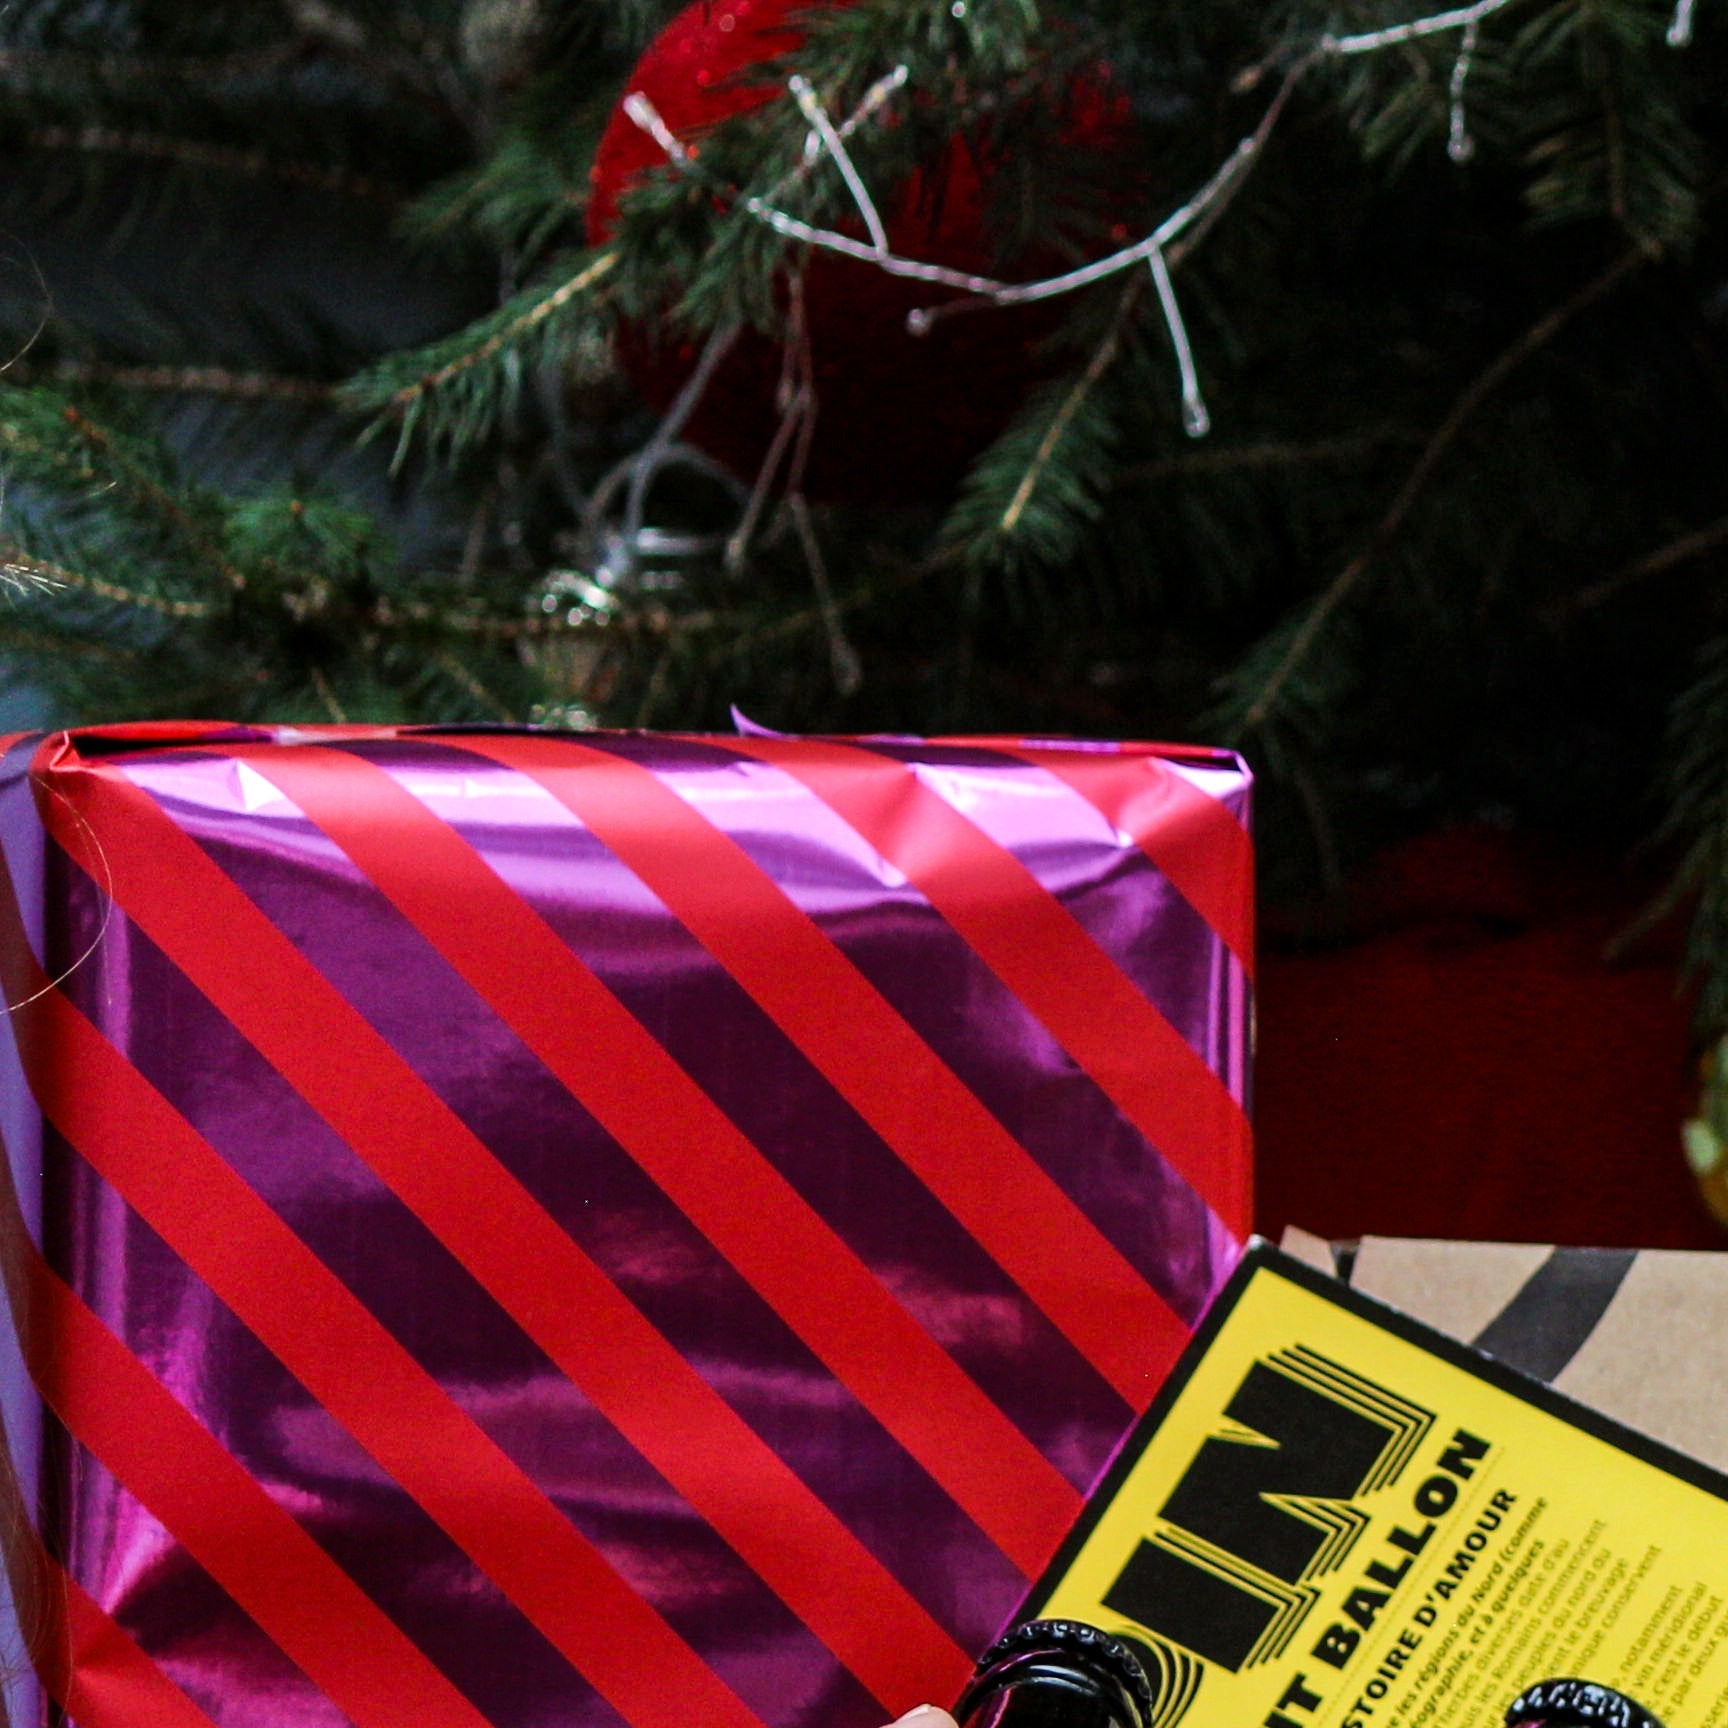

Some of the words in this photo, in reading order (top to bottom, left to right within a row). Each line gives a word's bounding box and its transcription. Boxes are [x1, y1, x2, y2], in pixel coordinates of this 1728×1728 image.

[1310, 1428, 1491, 1671] BALLON
[1413, 1489, 1516, 1628] D'AMOUR
[1469, 1625, 1486, 1645] et
[1481, 1614, 1494, 1627] à
[1491, 1540, 1545, 1614] quelques
[1574, 1558, 1629, 1630] breuvage
[1601, 1544, 1662, 1630] conservent
[1396, 1692, 1418, 1716] les
[1413, 1629, 1460, 1691] régions
[1456, 1604, 1476, 1628] du
[1470, 1561, 1504, 1604] Nord
[1498, 1497, 1547, 1563] (comme
[1475, 1682, 1499, 1705] les
[1490, 1617, 1542, 1681] Romains
[1528, 1519, 1607, 1616] commencent
[1475, 1609, 1524, 1671] diverses
[1518, 1572, 1547, 1608] date
[1511, 1631, 1557, 1695] peuples
[1552, 1608, 1572, 1630] du
[1566, 1569, 1597, 1607] nord
[1591, 1548, 1612, 1571] du
[1619, 1585, 1683, 1673] notamment
[1649, 1581, 1707, 1665] méridional
[1674, 1643, 1692, 1659] le
[1687, 1595, 1724, 1642] début
[1670, 1677, 1693, 1707] par
[1688, 1638, 1719, 1677] deux
